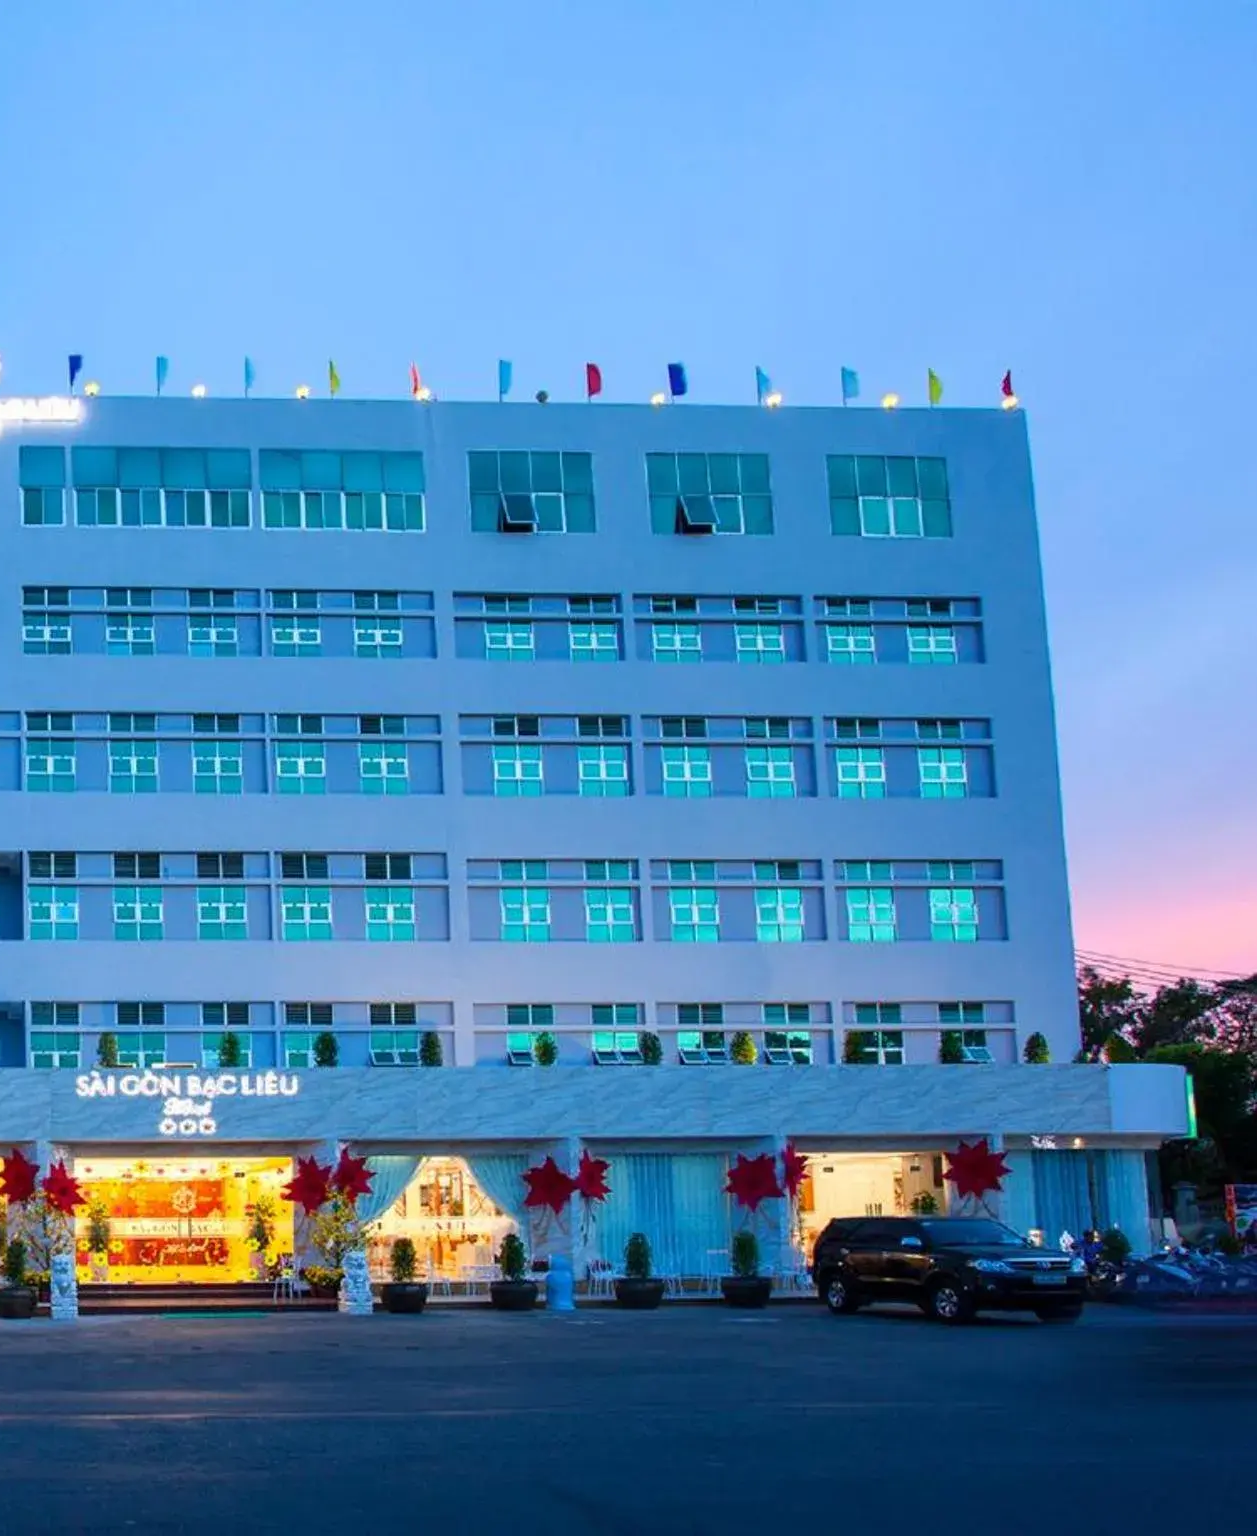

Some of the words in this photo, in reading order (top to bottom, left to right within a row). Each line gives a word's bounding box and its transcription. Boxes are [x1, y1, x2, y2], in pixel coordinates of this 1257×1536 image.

[76, 1071, 115, 1096] SÀI
[119, 1069, 181, 1096] GÒN
[187, 1075, 237, 1098] BẠC
[240, 1070, 299, 1096] LIÊU
